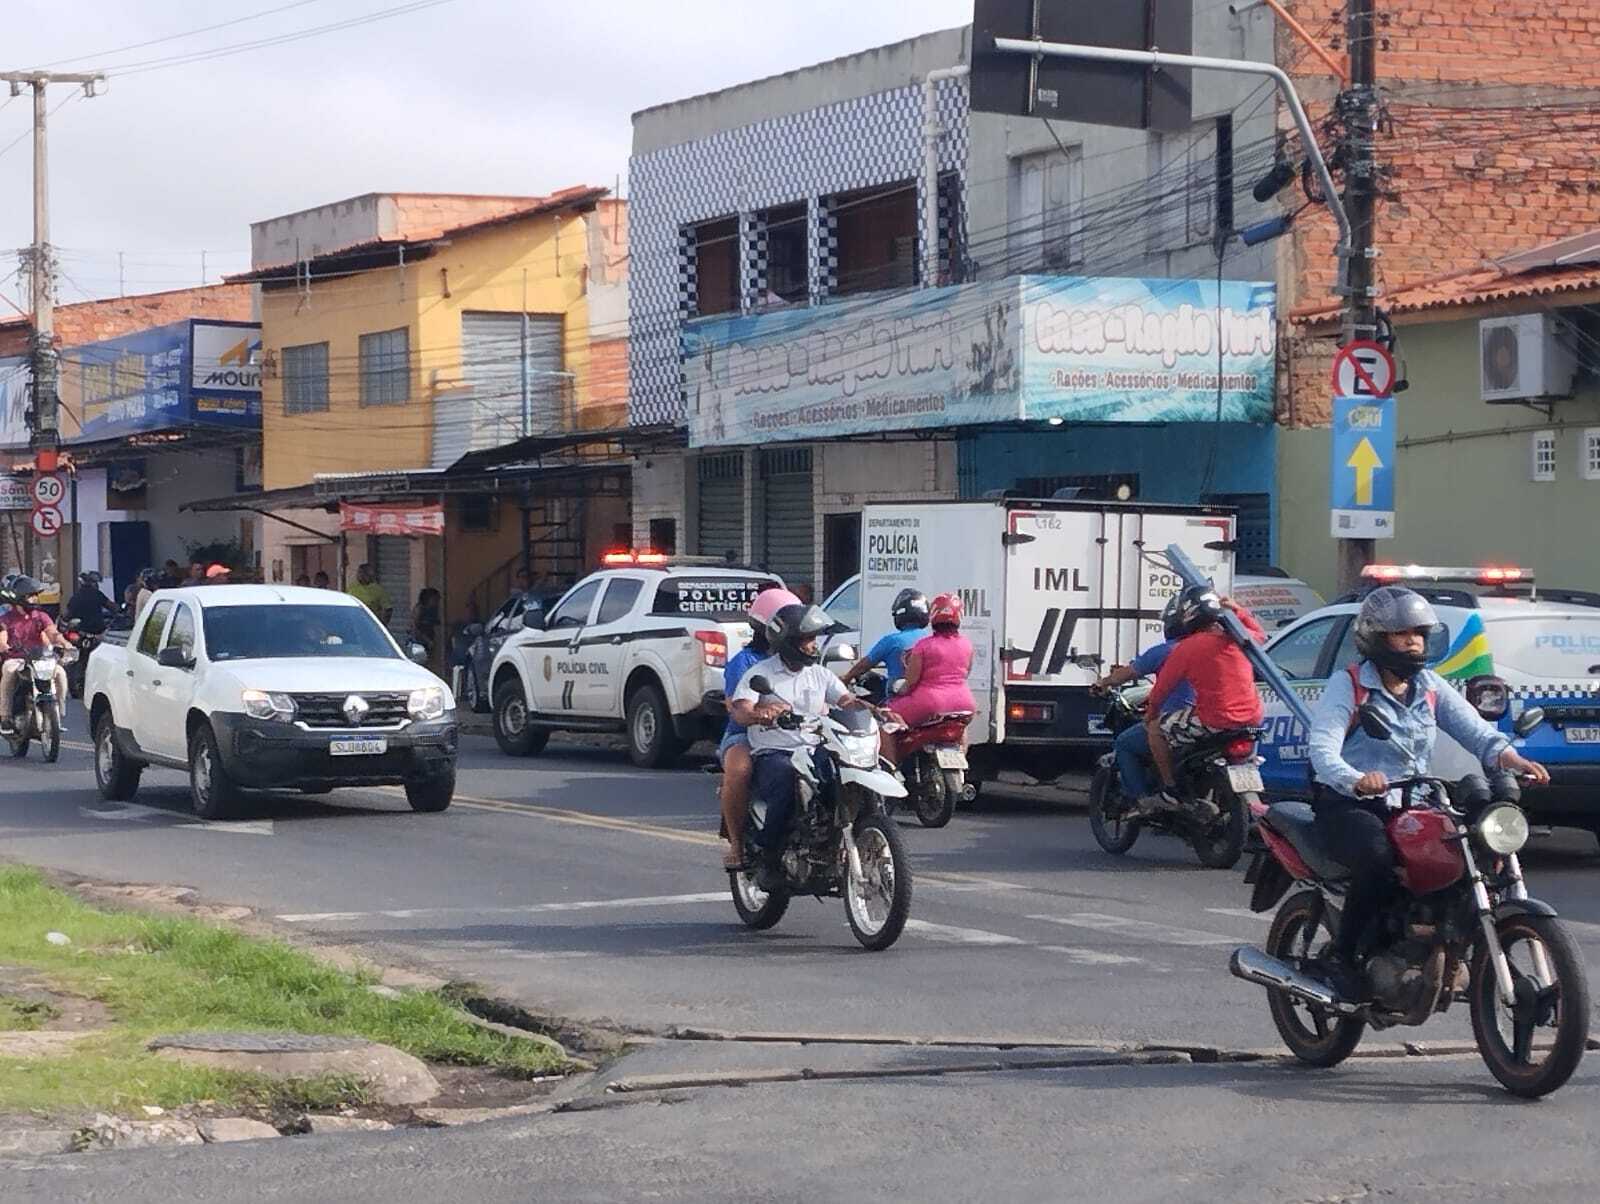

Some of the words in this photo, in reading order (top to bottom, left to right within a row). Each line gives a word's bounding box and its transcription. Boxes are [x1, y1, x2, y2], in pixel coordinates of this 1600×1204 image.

[1056, 370, 1097, 389] Rações
[1106, 372, 1168, 388] Acessórios
[1178, 372, 1257, 389] Medicamentos
[799, 400, 858, 424] Acessórios
[866, 393, 946, 418] Medicamentos
[39, 481, 60, 497] 50
[869, 530, 918, 554] POLÍCIA
[1034, 567, 1090, 592] IML
[679, 600, 753, 613] CIENTÍFIC
[588, 661, 609, 674] CIVIL
[1571, 727, 1600, 741] SLR7
